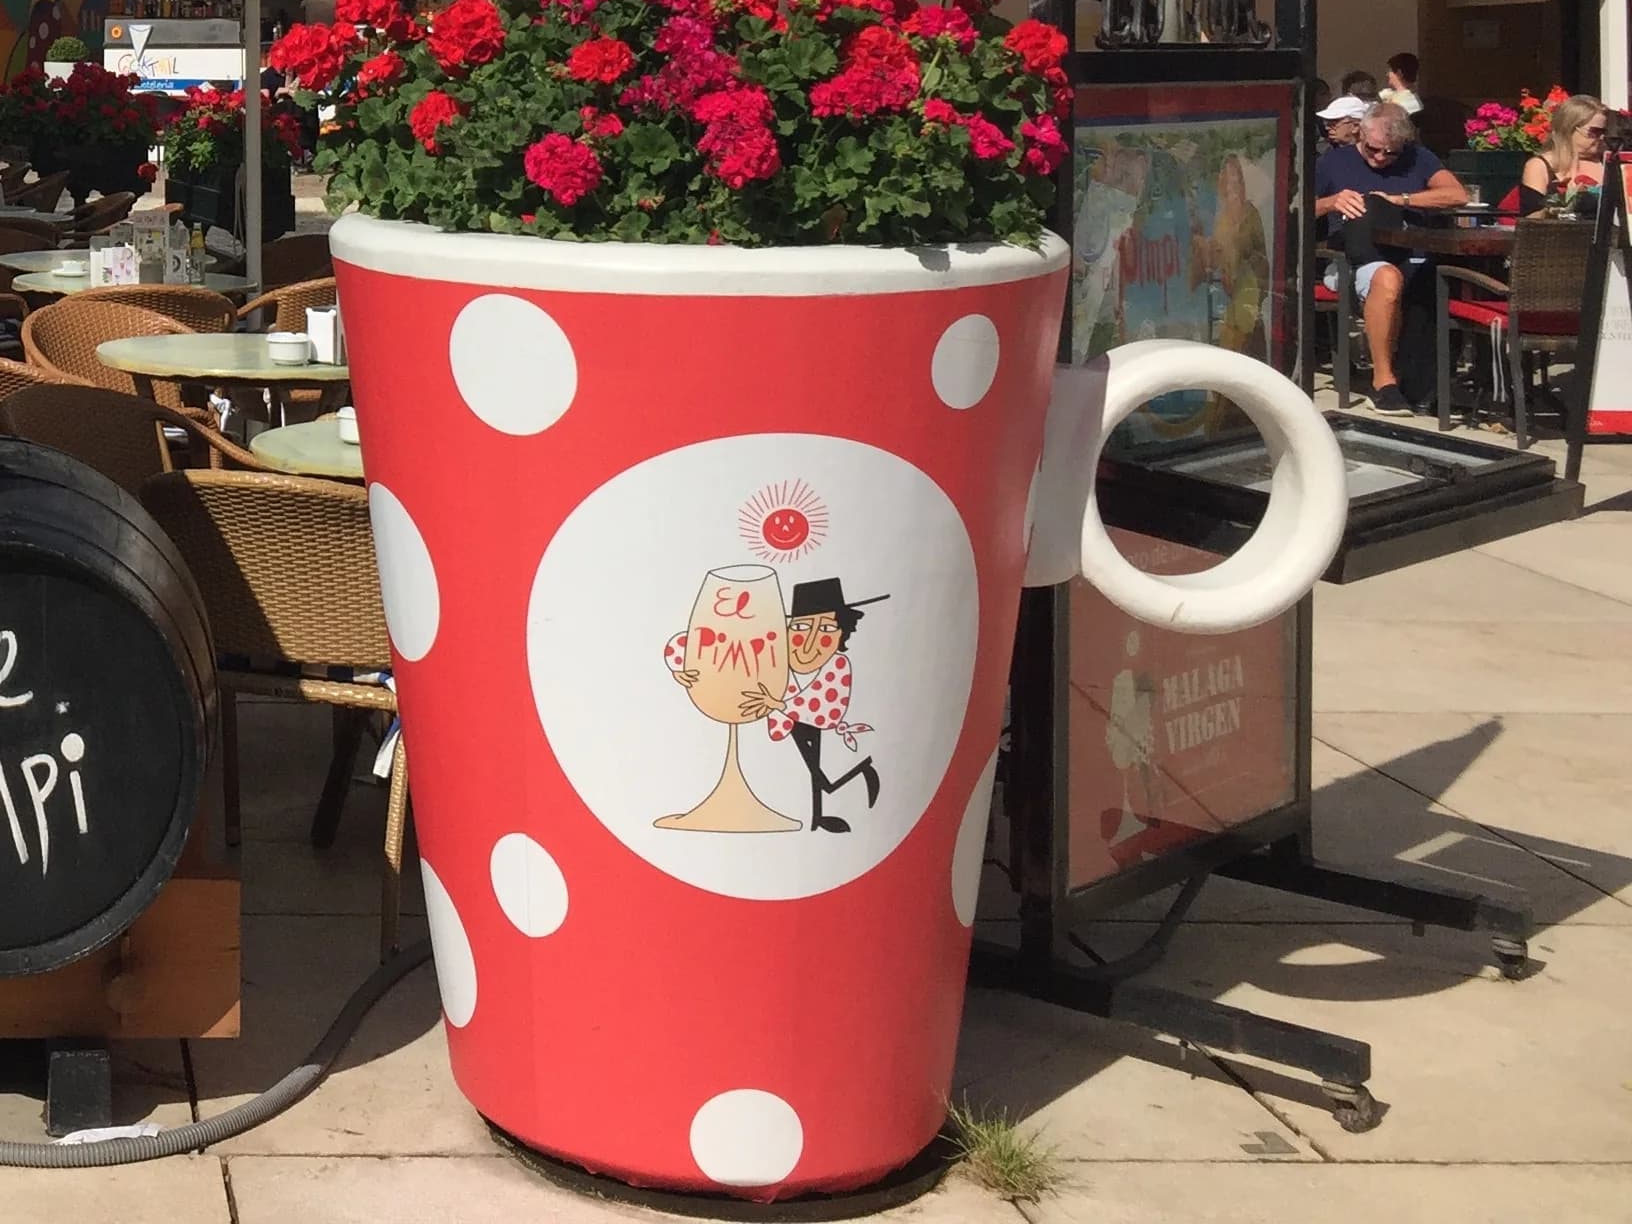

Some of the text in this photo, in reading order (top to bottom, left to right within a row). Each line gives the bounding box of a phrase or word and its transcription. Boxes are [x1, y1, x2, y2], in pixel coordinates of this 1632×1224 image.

[713, 586, 757, 620] El
[1162, 655, 1245, 713] MALAGA
[1164, 697, 1241, 755] VIRGEN
